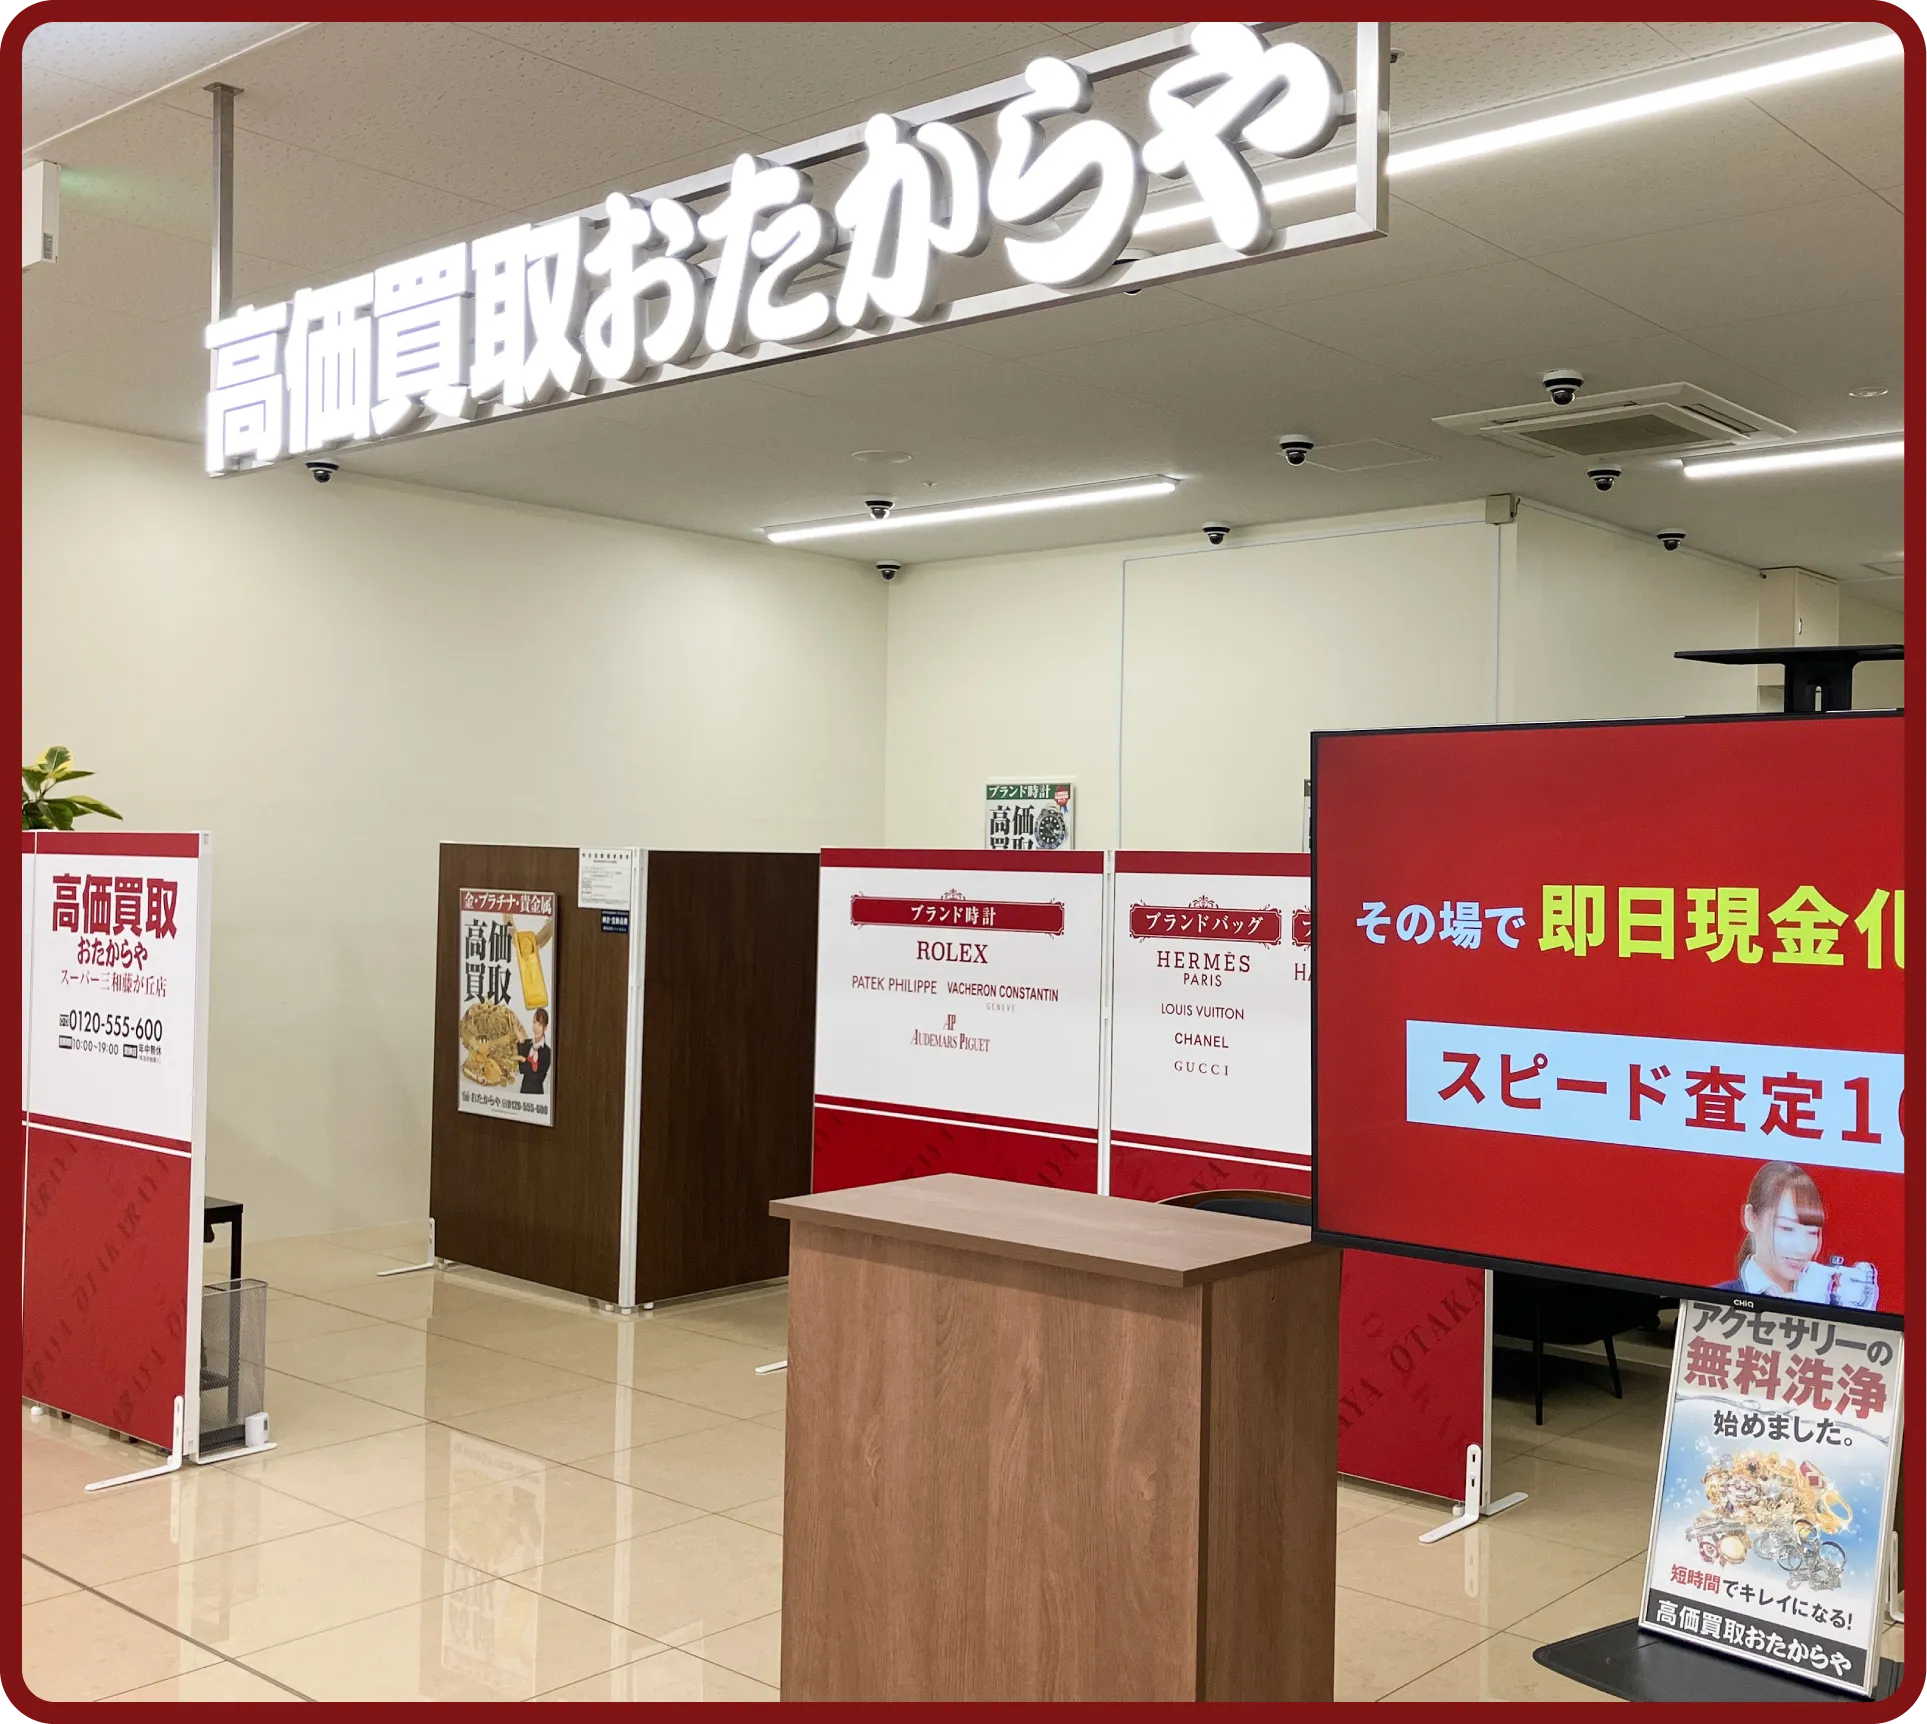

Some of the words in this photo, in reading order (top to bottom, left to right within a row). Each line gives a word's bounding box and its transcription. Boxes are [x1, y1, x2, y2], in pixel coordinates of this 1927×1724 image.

[204, 22, 1342, 476] 高価買取おたからや
[988, 784, 1051, 799] ブランド時計
[989, 805, 1035, 836] 高価
[52, 873, 178, 939] 高価買取
[464, 891, 552, 915] 金・プラチナ・貴金属
[910, 904, 996, 927] ブランド時計
[1145, 911, 1264, 935] ブランドバッグ
[464, 918, 514, 963] 高価
[917, 941, 988, 964] ROLEX
[77, 936, 148, 971] おたからや
[1157, 950, 1250, 973] HERMÈS
[464, 960, 512, 1004] 買取
[852, 975, 885, 990] PATEK
[888, 978, 937, 994] PHILIPPE
[947, 981, 997, 998] VACHERON
[999, 985, 1059, 1002] CONSTANTIN
[1183, 973, 1222, 987] PARIS
[1161, 1003, 1193, 1017] LOUIS
[1196, 1005, 1244, 1020] VUITTON
[69, 1009, 163, 1042] 0120-555-600
[959, 1033, 990, 1052] PIGUET
[1174, 1032, 1229, 1048] CHANEL
[1174, 1061, 1229, 1076] GUCCI
[1437, 1051, 1904, 1144] スピード査定1
[1692, 1303, 1893, 1367] アクセサリーの
[1683, 1335, 1887, 1420] 無料洗浄
[1713, 1410, 1853, 1447] 始めました。
[1656, 1599, 1852, 1676] 高価買取おたからや
